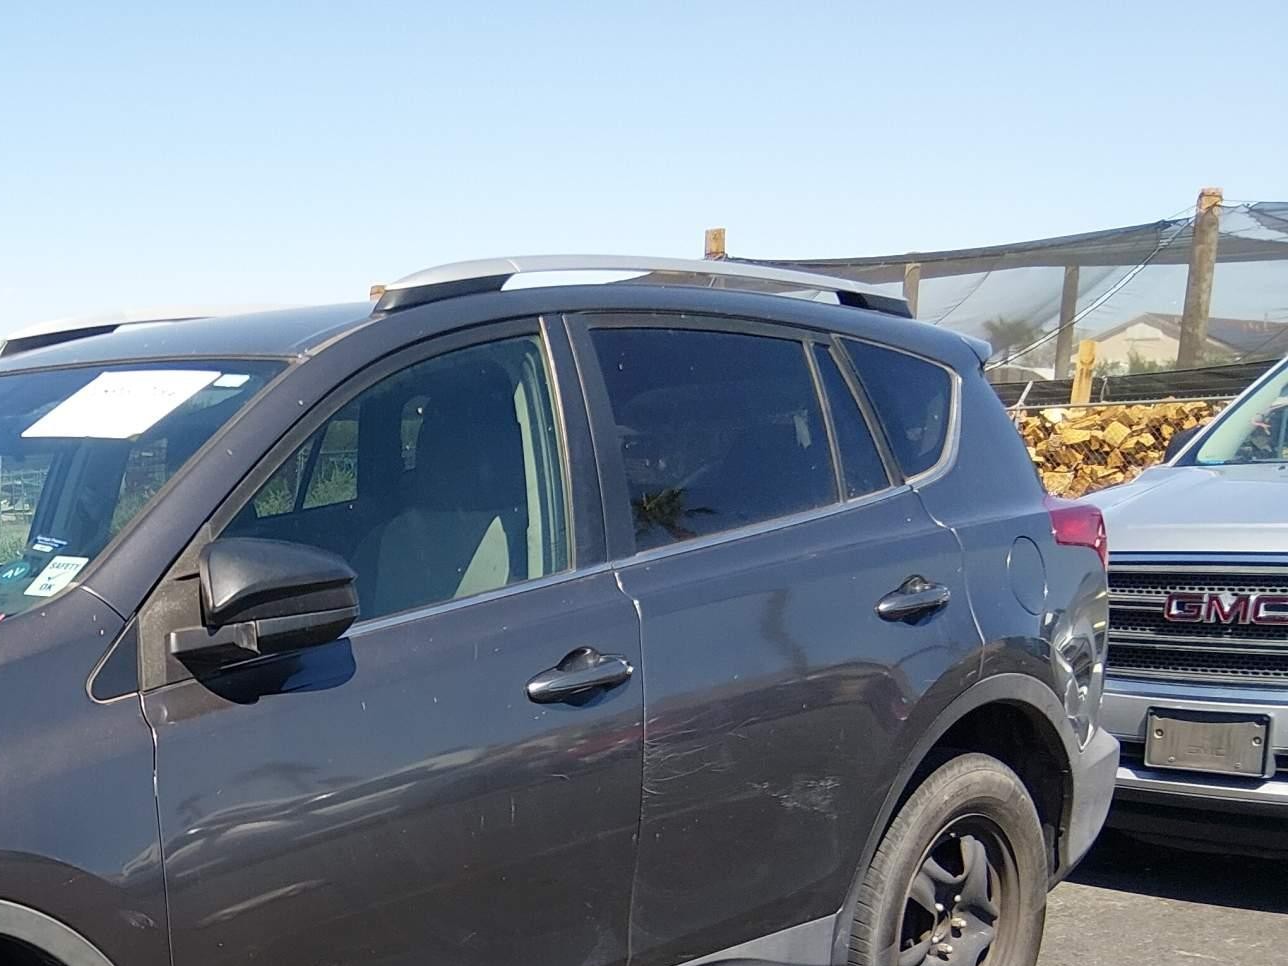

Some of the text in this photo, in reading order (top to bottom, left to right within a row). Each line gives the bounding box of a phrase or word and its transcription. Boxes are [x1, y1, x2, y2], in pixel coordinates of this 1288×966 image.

[49, 562, 80, 571] SAFETY
[39, 583, 55, 592] OK
[1163, 593, 1288, 625] GMC
